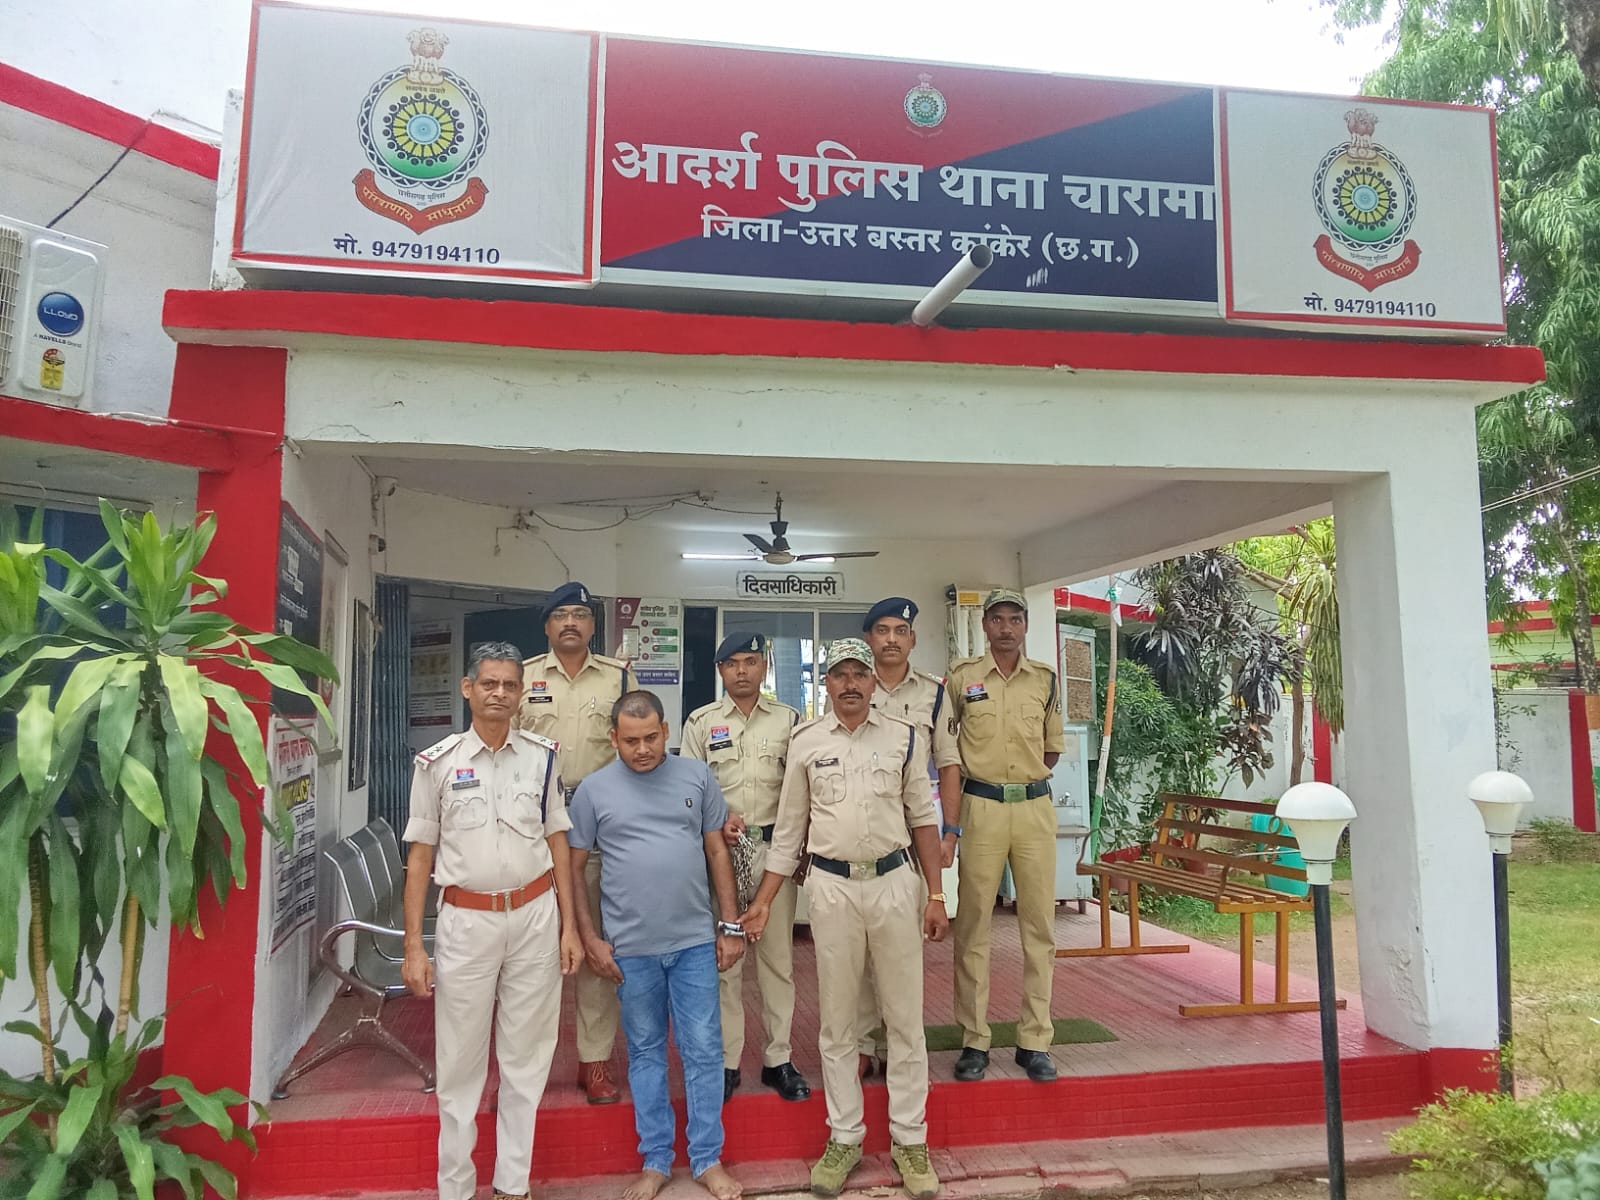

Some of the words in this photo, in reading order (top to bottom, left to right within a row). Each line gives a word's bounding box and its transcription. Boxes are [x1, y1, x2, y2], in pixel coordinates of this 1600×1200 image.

[611, 131, 762, 190] आदर्श
[776, 140, 924, 212] पुलिस
[939, 165, 1049, 210] थाना
[1062, 174, 1216, 221] चारामा
[333, 233, 362, 256] मो.
[372, 240, 500, 265] 9479194110
[866, 225, 942, 253] बस्तर
[1041, 231, 1139, 269] (छ.ग.)
[43, 306, 79, 321] LLOYD
[1303, 292, 1328, 312] मो.
[1334, 298, 1437, 318] 9479194110
[743, 575, 837, 596] दिवसाधिकारी
